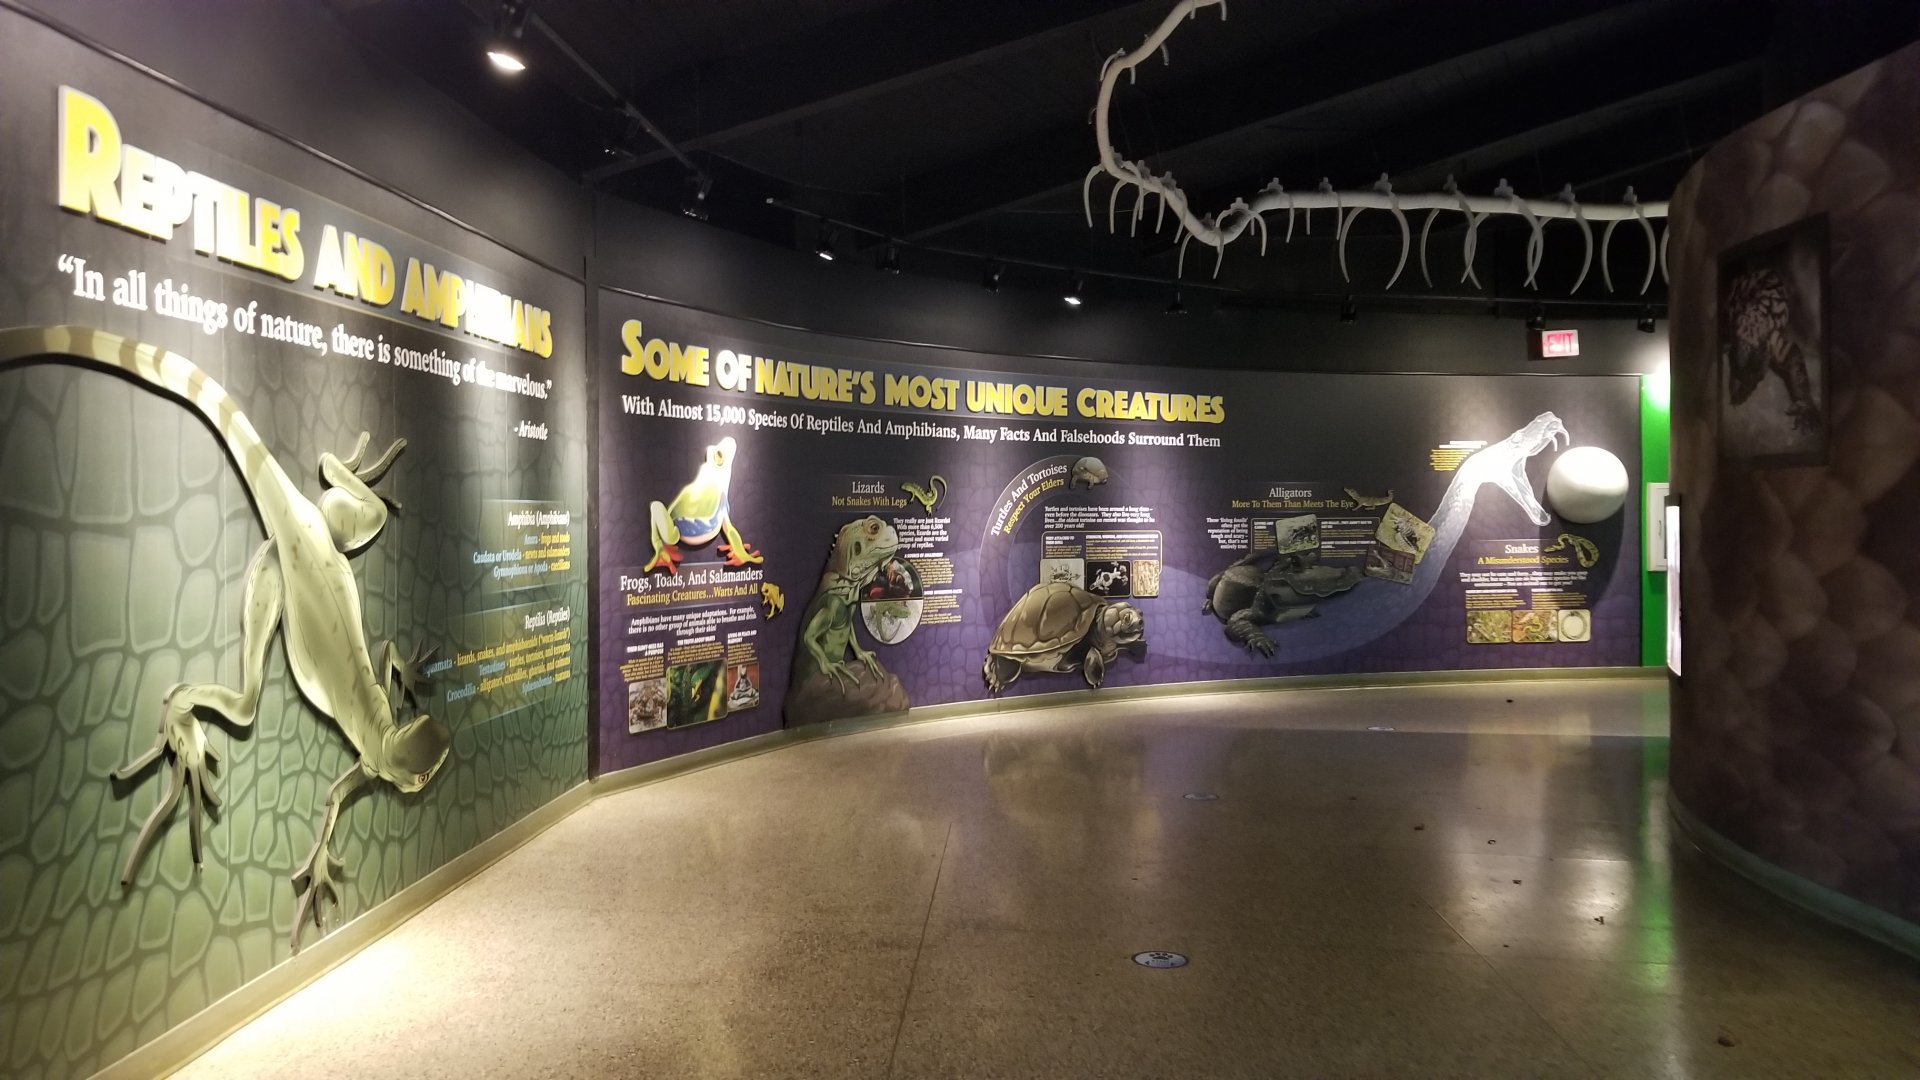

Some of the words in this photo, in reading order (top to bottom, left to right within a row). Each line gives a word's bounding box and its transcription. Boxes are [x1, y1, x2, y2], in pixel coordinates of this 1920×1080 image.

[58, 84, 304, 281] REPTILES
[313, 224, 396, 306] AND
[401, 256, 553, 359] AMPHIBIANS
[113, 269, 148, 311] all
[154, 278, 228, 335] things
[233, 300, 258, 335] of
[261, 313, 328, 356] nature,
[332, 323, 374, 361] there
[378, 334, 391, 364] is
[394, 346, 462, 386] something
[462, 357, 476, 384] of
[476, 360, 496, 389] the
[1547, 332, 1574, 353] EXIT
[621, 319, 710, 387] SOME
[715, 349, 752, 393] OF
[884, 373, 960, 410] MOST
[966, 380, 1069, 417] UNIQUE
[1076, 387, 1226, 424] CREATURES
[519, 419, 549, 440] Aristotle
[621, 394, 654, 416] With
[658, 398, 703, 421] Almost
[706, 403, 746, 427] 15,000
[748, 409, 788, 431] Species
[790, 412, 804, 430] Of
[806, 416, 854, 438] Reptiles
[857, 418, 882, 436] And
[885, 421, 960, 441] Amphibians,
[964, 425, 997, 444] Many
[1000, 426, 1030, 442] Facts
[1033, 427, 1057, 443] And
[1060, 429, 1126, 445] Falsehoods
[1128, 431, 1184, 447] Surround
[1187, 433, 1221, 448] Them
[852, 481, 885, 494] Lizards
[1268, 487, 1313, 499] Alligators
[832, 496, 845, 507] Not
[846, 496, 872, 507] Snakes
[873, 496, 890, 507] With
[891, 496, 907, 508] Legs
[991, 499, 1014, 536] Turtles
[1011, 478, 1029, 503] And
[1027, 464, 1068, 485] Tortoises
[1003, 501, 1026, 535] Respect
[1022, 486, 1041, 503] Your
[1041, 478, 1065, 491] Elders
[1232, 500, 1251, 508] More
[1252, 500, 1261, 508] To
[1261, 500, 1281, 508] Them
[1283, 500, 1302, 508] Than
[1303, 500, 1324, 508] Meets
[1326, 500, 1340, 508] The
[1340, 500, 1354, 510] Eye
[508, 510, 535, 530] Amphibia
[1504, 544, 1539, 554] Snakes
[1485, 556, 1540, 565] Misunderstood
[1541, 556, 1569, 565] Species
[620, 574, 652, 593] Frogs,
[655, 571, 686, 590] Toads,
[688, 571, 707, 586] And
[709, 567, 764, 583] Salamanders
[626, 590, 671, 606] Fascinating
[733, 584, 748, 596] And
[748, 583, 758, 595] All
[525, 611, 546, 632] Reptilia
[546, 606, 570, 626] (Reptiles)
[628, 626, 642, 635] there
[642, 625, 647, 633] is
[648, 624, 655, 632] no
[655, 622, 668, 631] other
[668, 621, 682, 631] group
[682, 620, 689, 628] of
[738, 613, 746, 621] and
[746, 612, 757, 620] drink
[631, 616, 660, 627] Amphibians
[660, 614, 672, 623] have
[672, 613, 685, 623] many
[685, 611, 701, 621] unique
[729, 607, 737, 615] For
[676, 627, 695, 637] through
[695, 625, 706, 634] their
[457, 649, 476, 666] lizards,
[495, 642, 505, 656] and
[447, 681, 476, 703] Crocodilia
